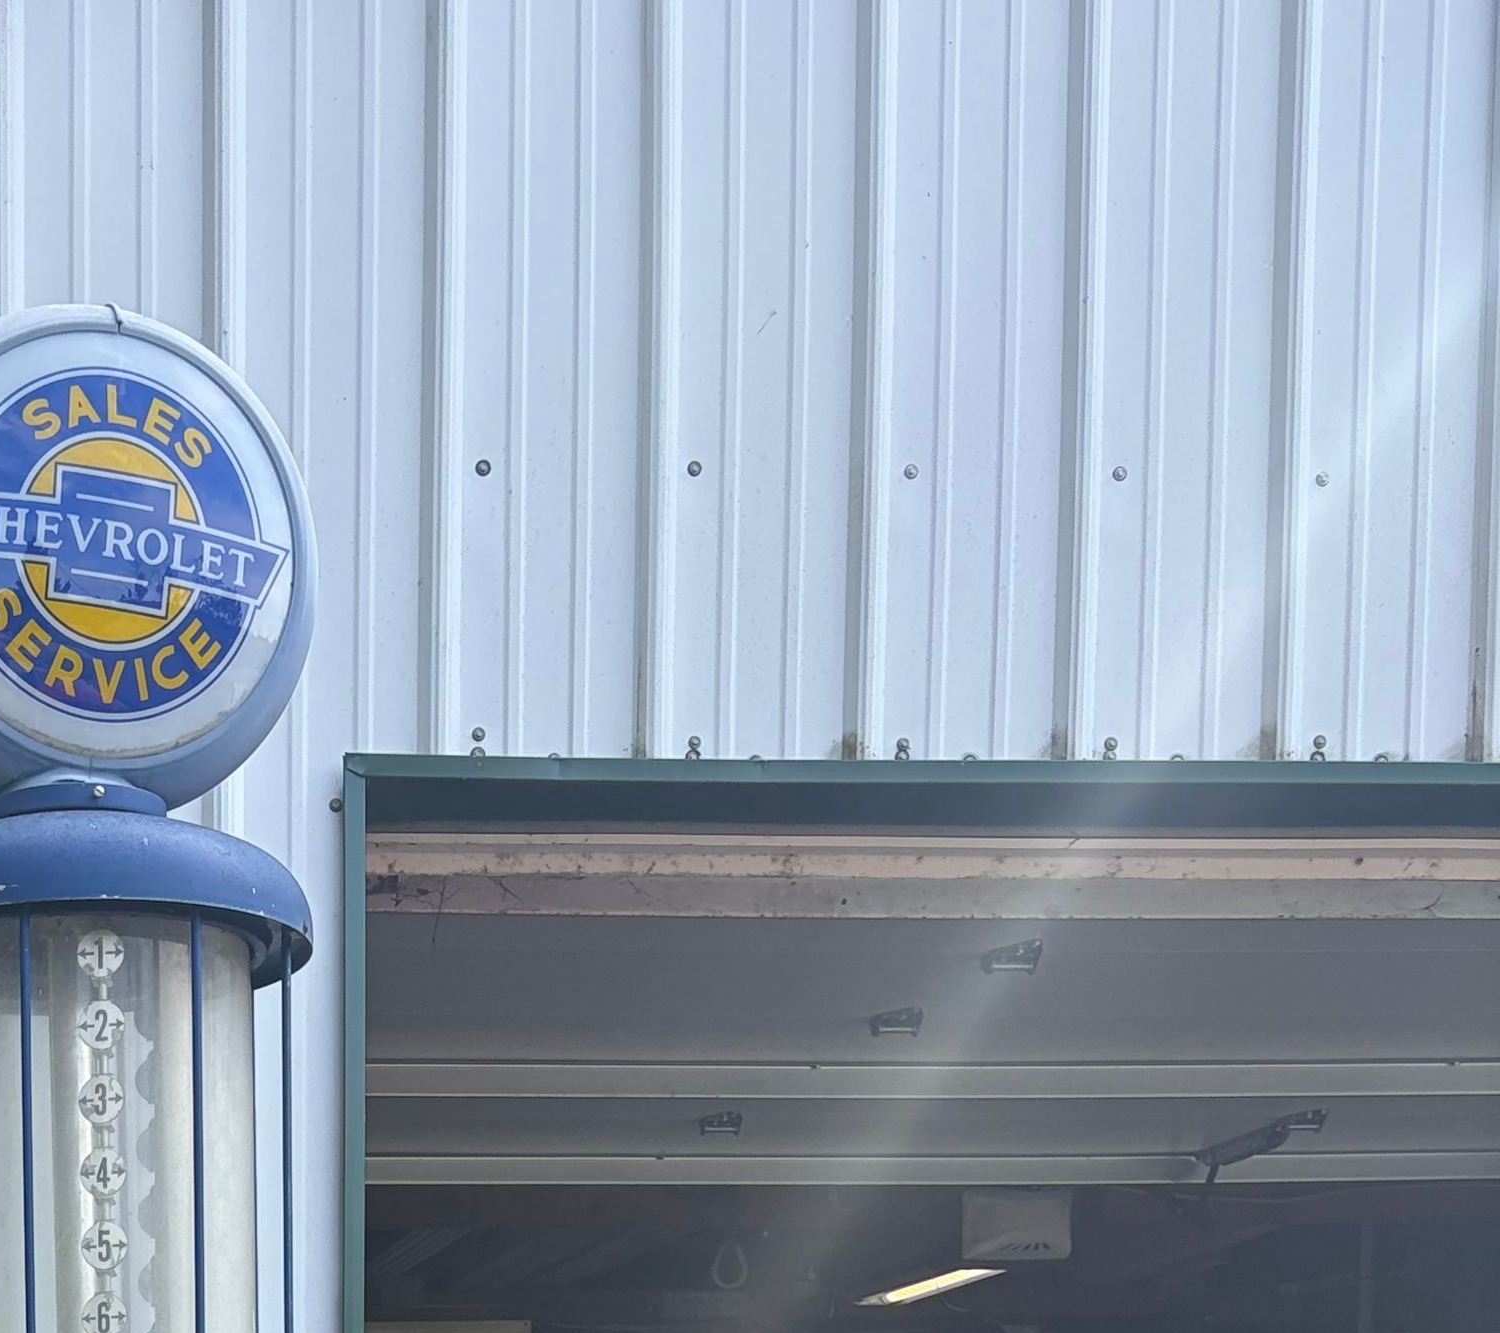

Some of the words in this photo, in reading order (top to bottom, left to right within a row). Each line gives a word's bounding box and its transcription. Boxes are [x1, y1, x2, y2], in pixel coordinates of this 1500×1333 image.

[21, 383, 212, 468] SALES
[95, 939, 104, 969] 1
[94, 1009, 109, 1042] 2
[94, 1083, 107, 1116] 3
[96, 1157, 111, 1189] 4
[97, 1229, 112, 1263] 5
[97, 1301, 110, 1333] 6
